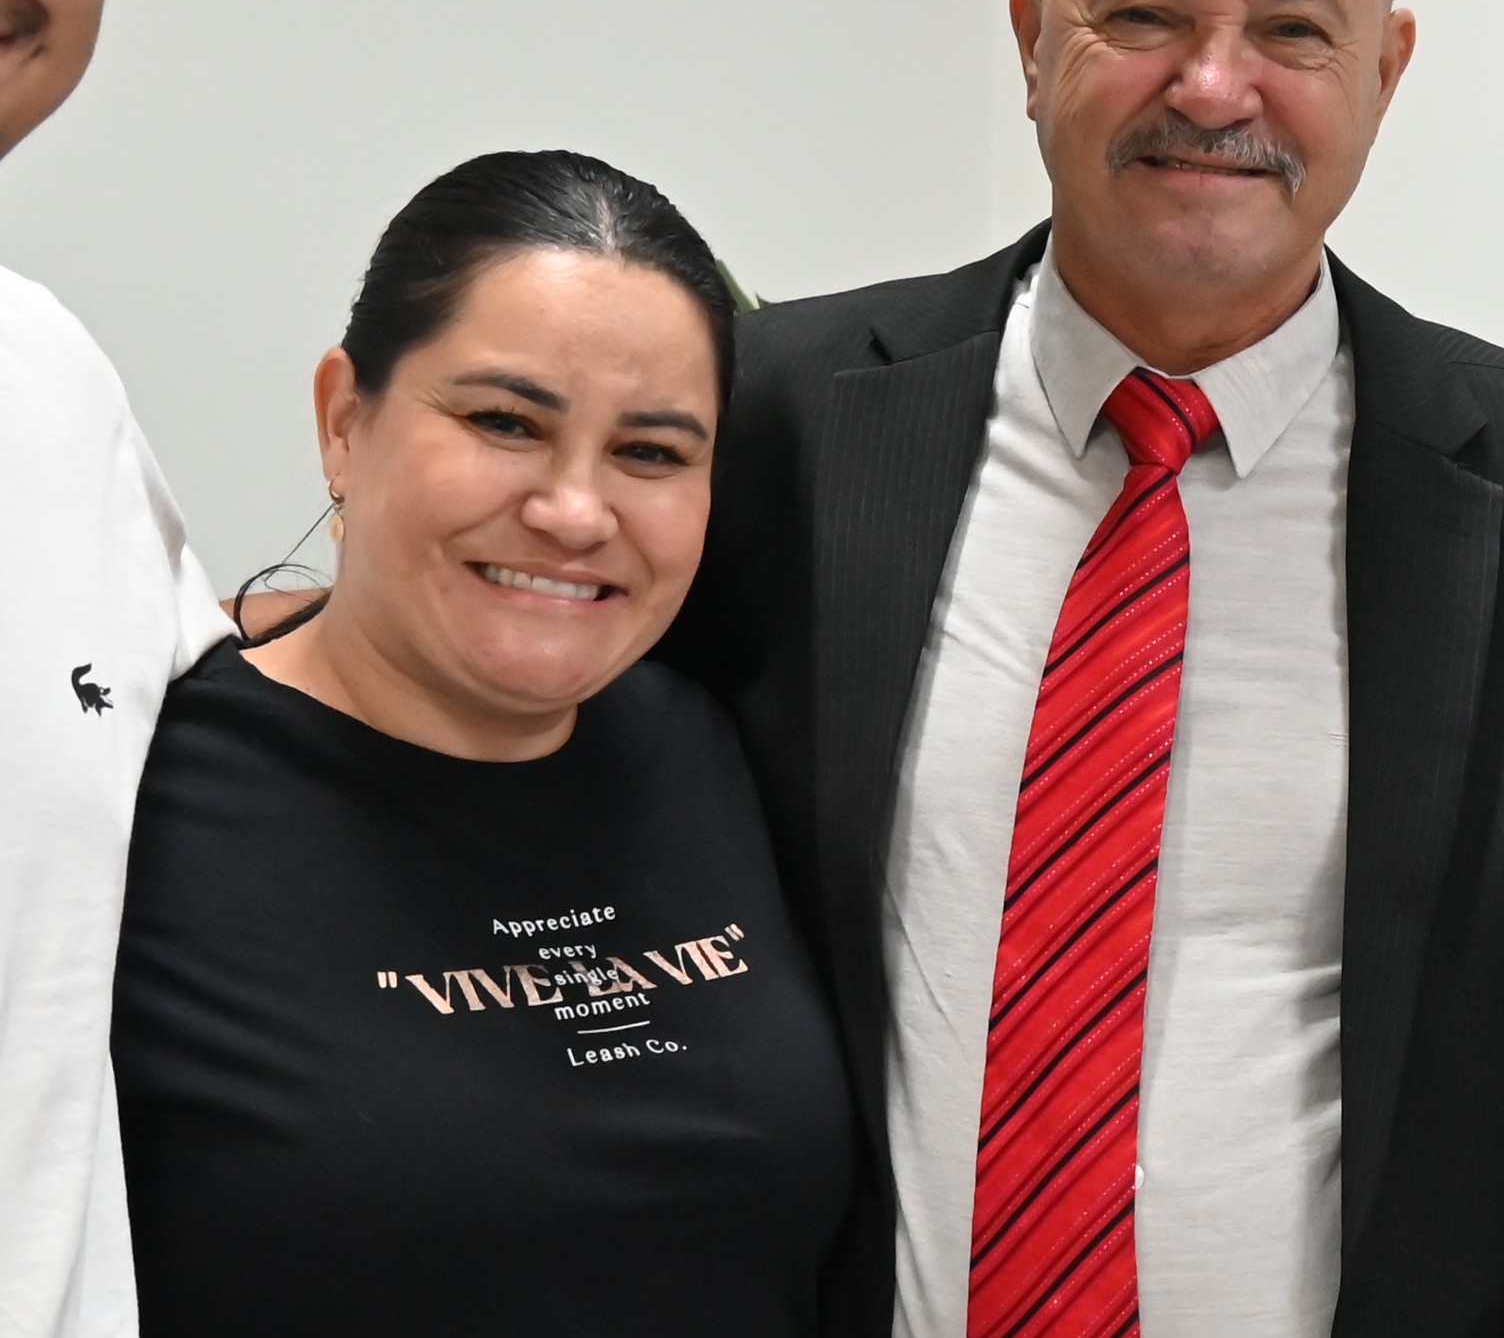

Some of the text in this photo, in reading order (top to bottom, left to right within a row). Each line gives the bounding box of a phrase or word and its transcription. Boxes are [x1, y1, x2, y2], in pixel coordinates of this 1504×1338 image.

[492, 904, 617, 939] Appreciate
[537, 943, 598, 961] every
[553, 964, 619, 988] single
[553, 992, 651, 1021] moment
[566, 1038, 688, 1068] Leash Co.
